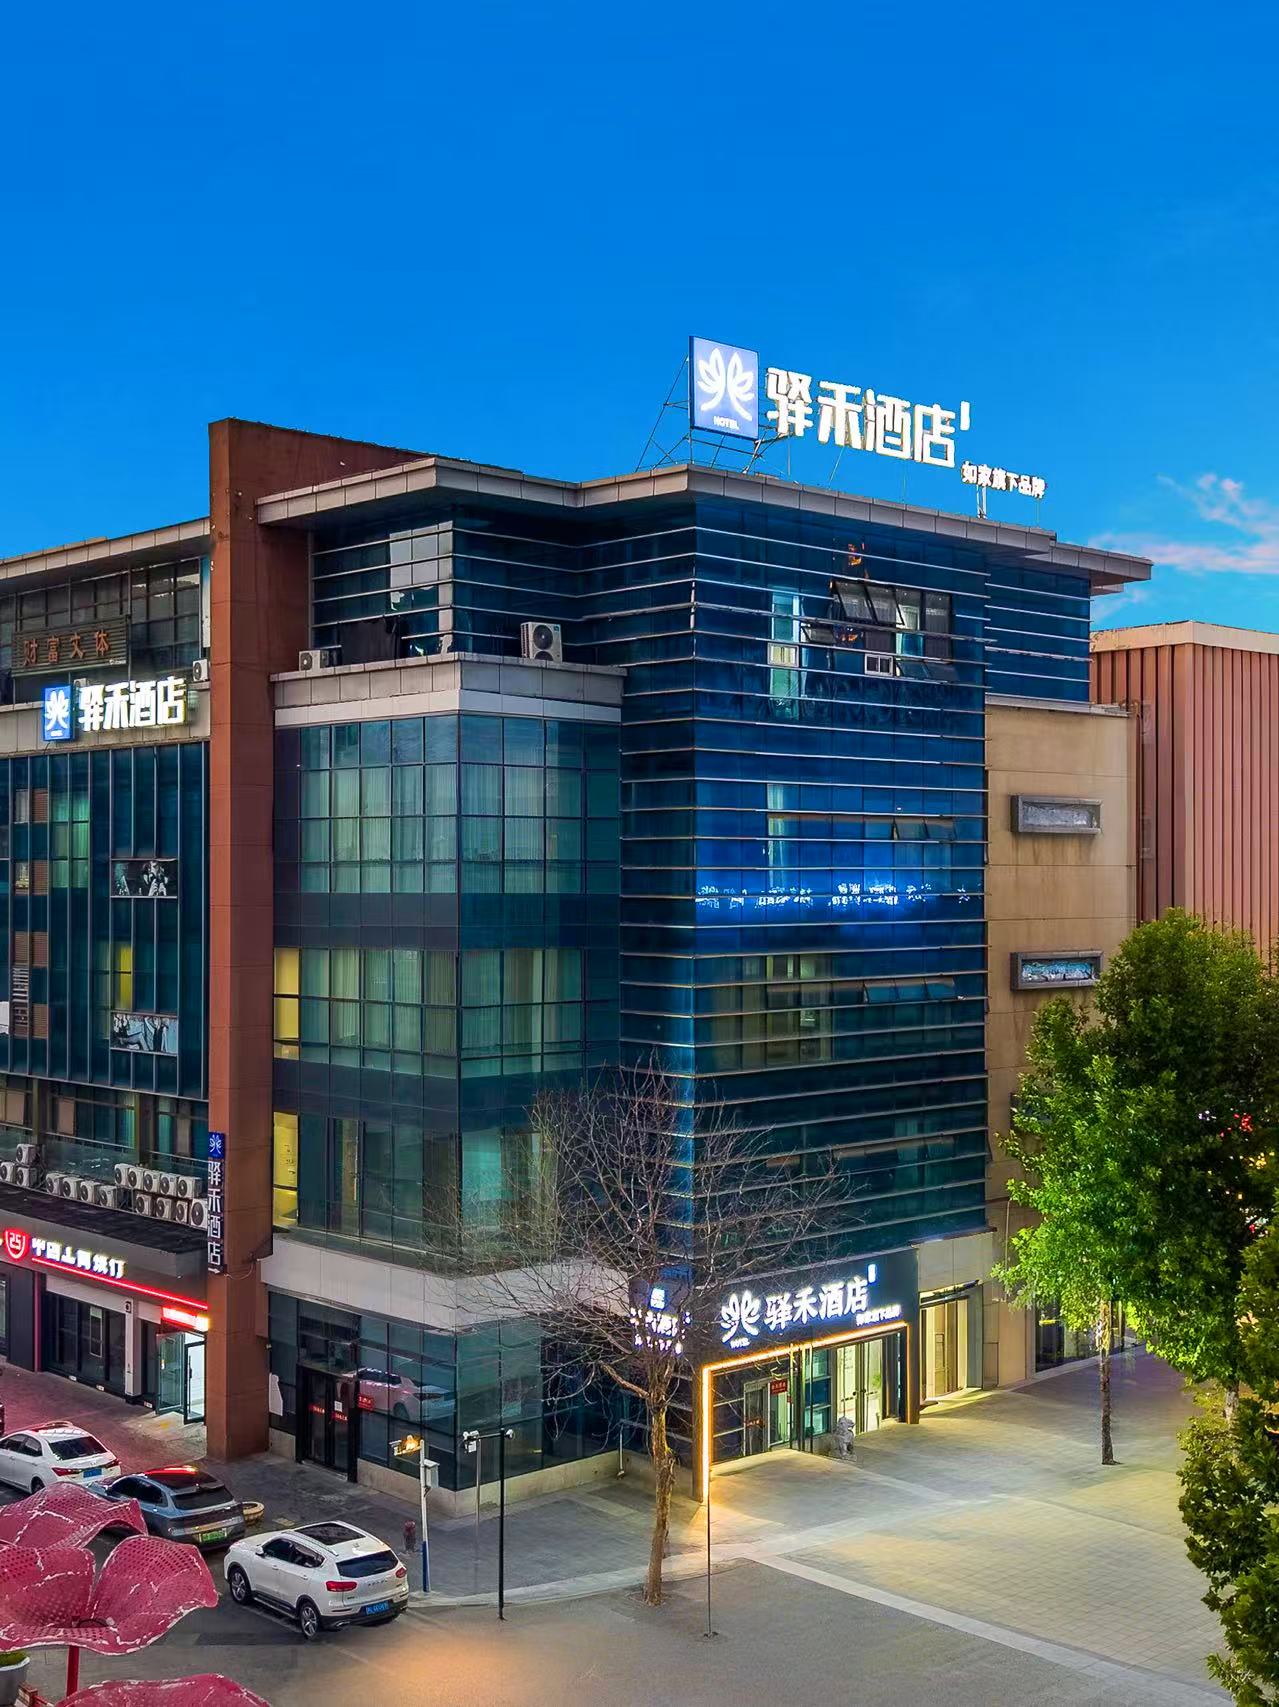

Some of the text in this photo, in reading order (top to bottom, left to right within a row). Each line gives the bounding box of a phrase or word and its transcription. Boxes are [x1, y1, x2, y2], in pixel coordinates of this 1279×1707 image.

[766, 367, 956, 468] 驿禾酒店
[78, 676, 187, 732] 驿禾酒店
[207, 1161, 221, 1266] 驿禾酒店
[764, 1277, 868, 1331] 驿禾酒店
